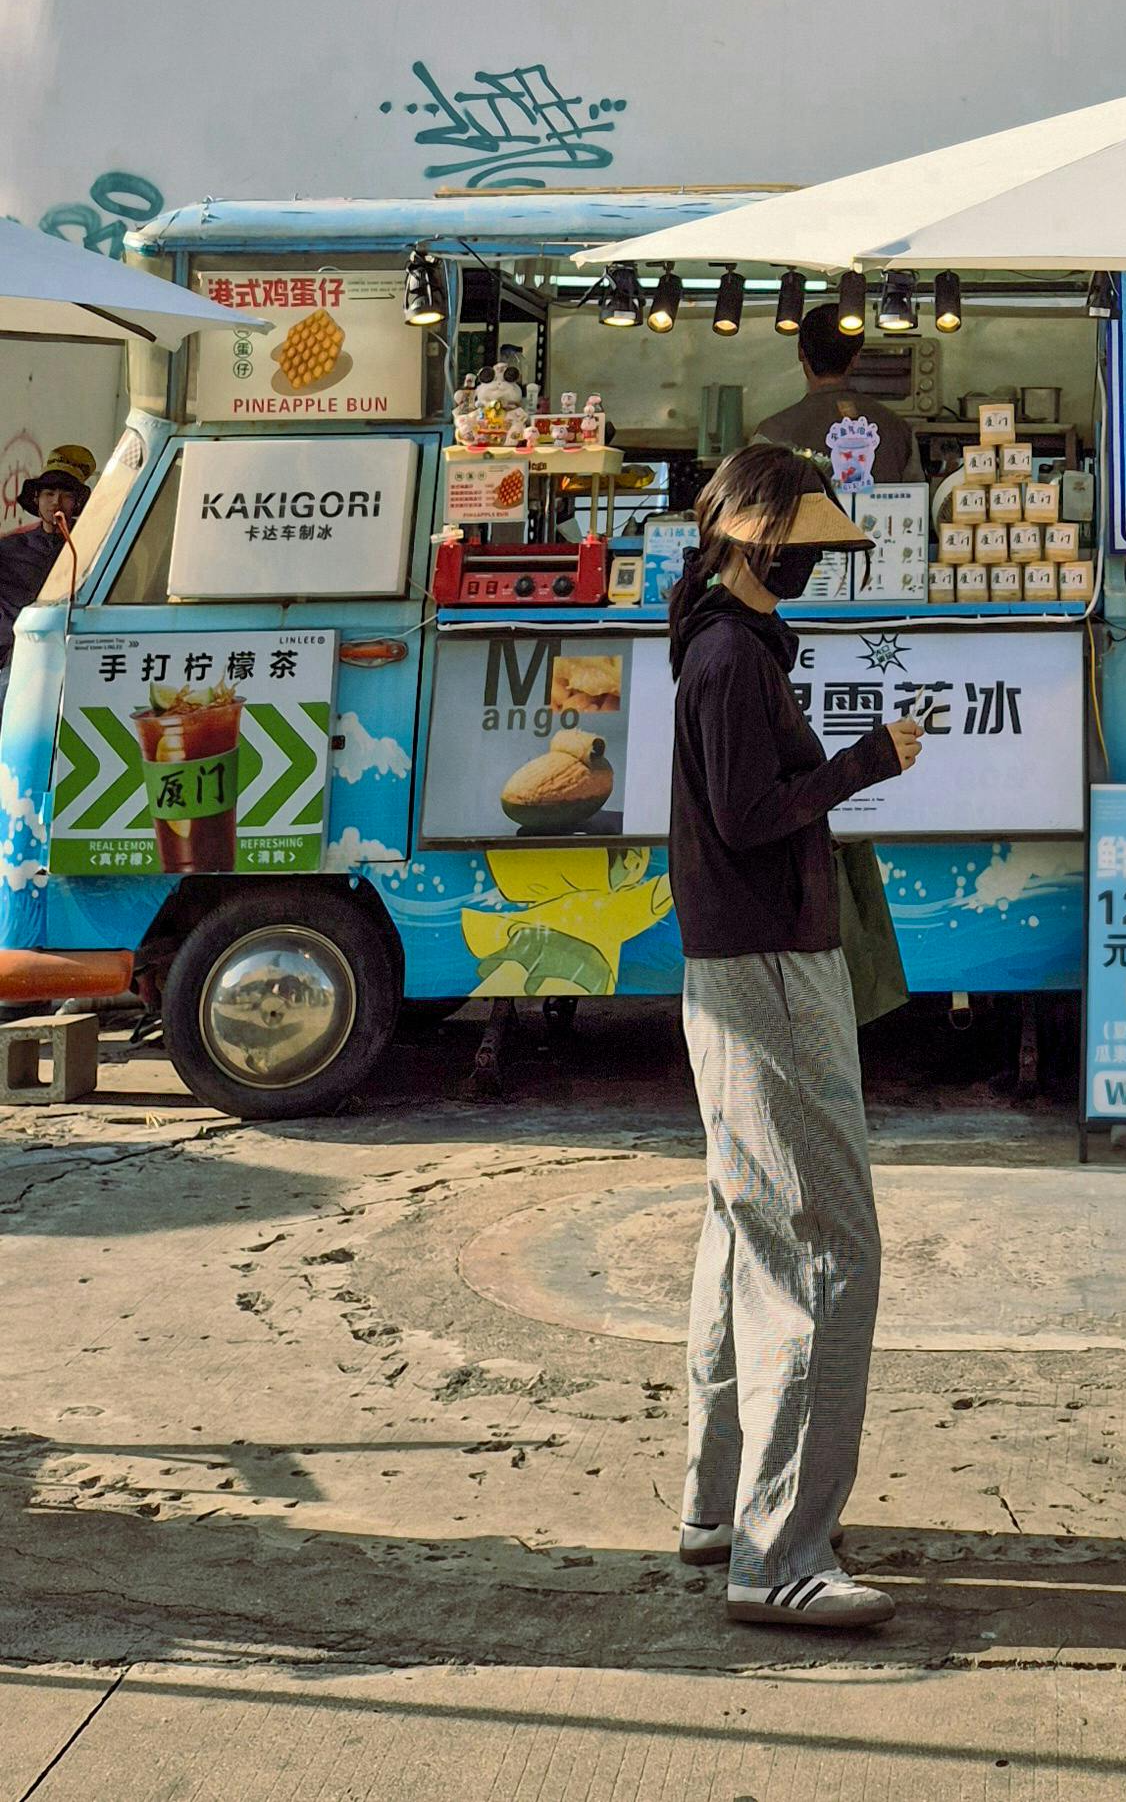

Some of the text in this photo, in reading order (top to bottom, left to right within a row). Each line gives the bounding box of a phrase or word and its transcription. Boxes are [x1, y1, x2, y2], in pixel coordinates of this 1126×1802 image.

[207, 277, 346, 308] 港式鸡蛋仔
[233, 396, 388, 414] PINEAPPLE BUN
[985, 416, 1008, 427] 厦门
[201, 490, 382, 520] KAKIGORI
[245, 523, 333, 542] 卡达车制冰
[279, 635, 317, 645] LINLEE
[98, 649, 299, 683] 手打柠檬茶
[156, 761, 226, 809] 厦门
[89, 840, 154, 851] REAL LEMON
[240, 836, 304, 850] REFRESHING
